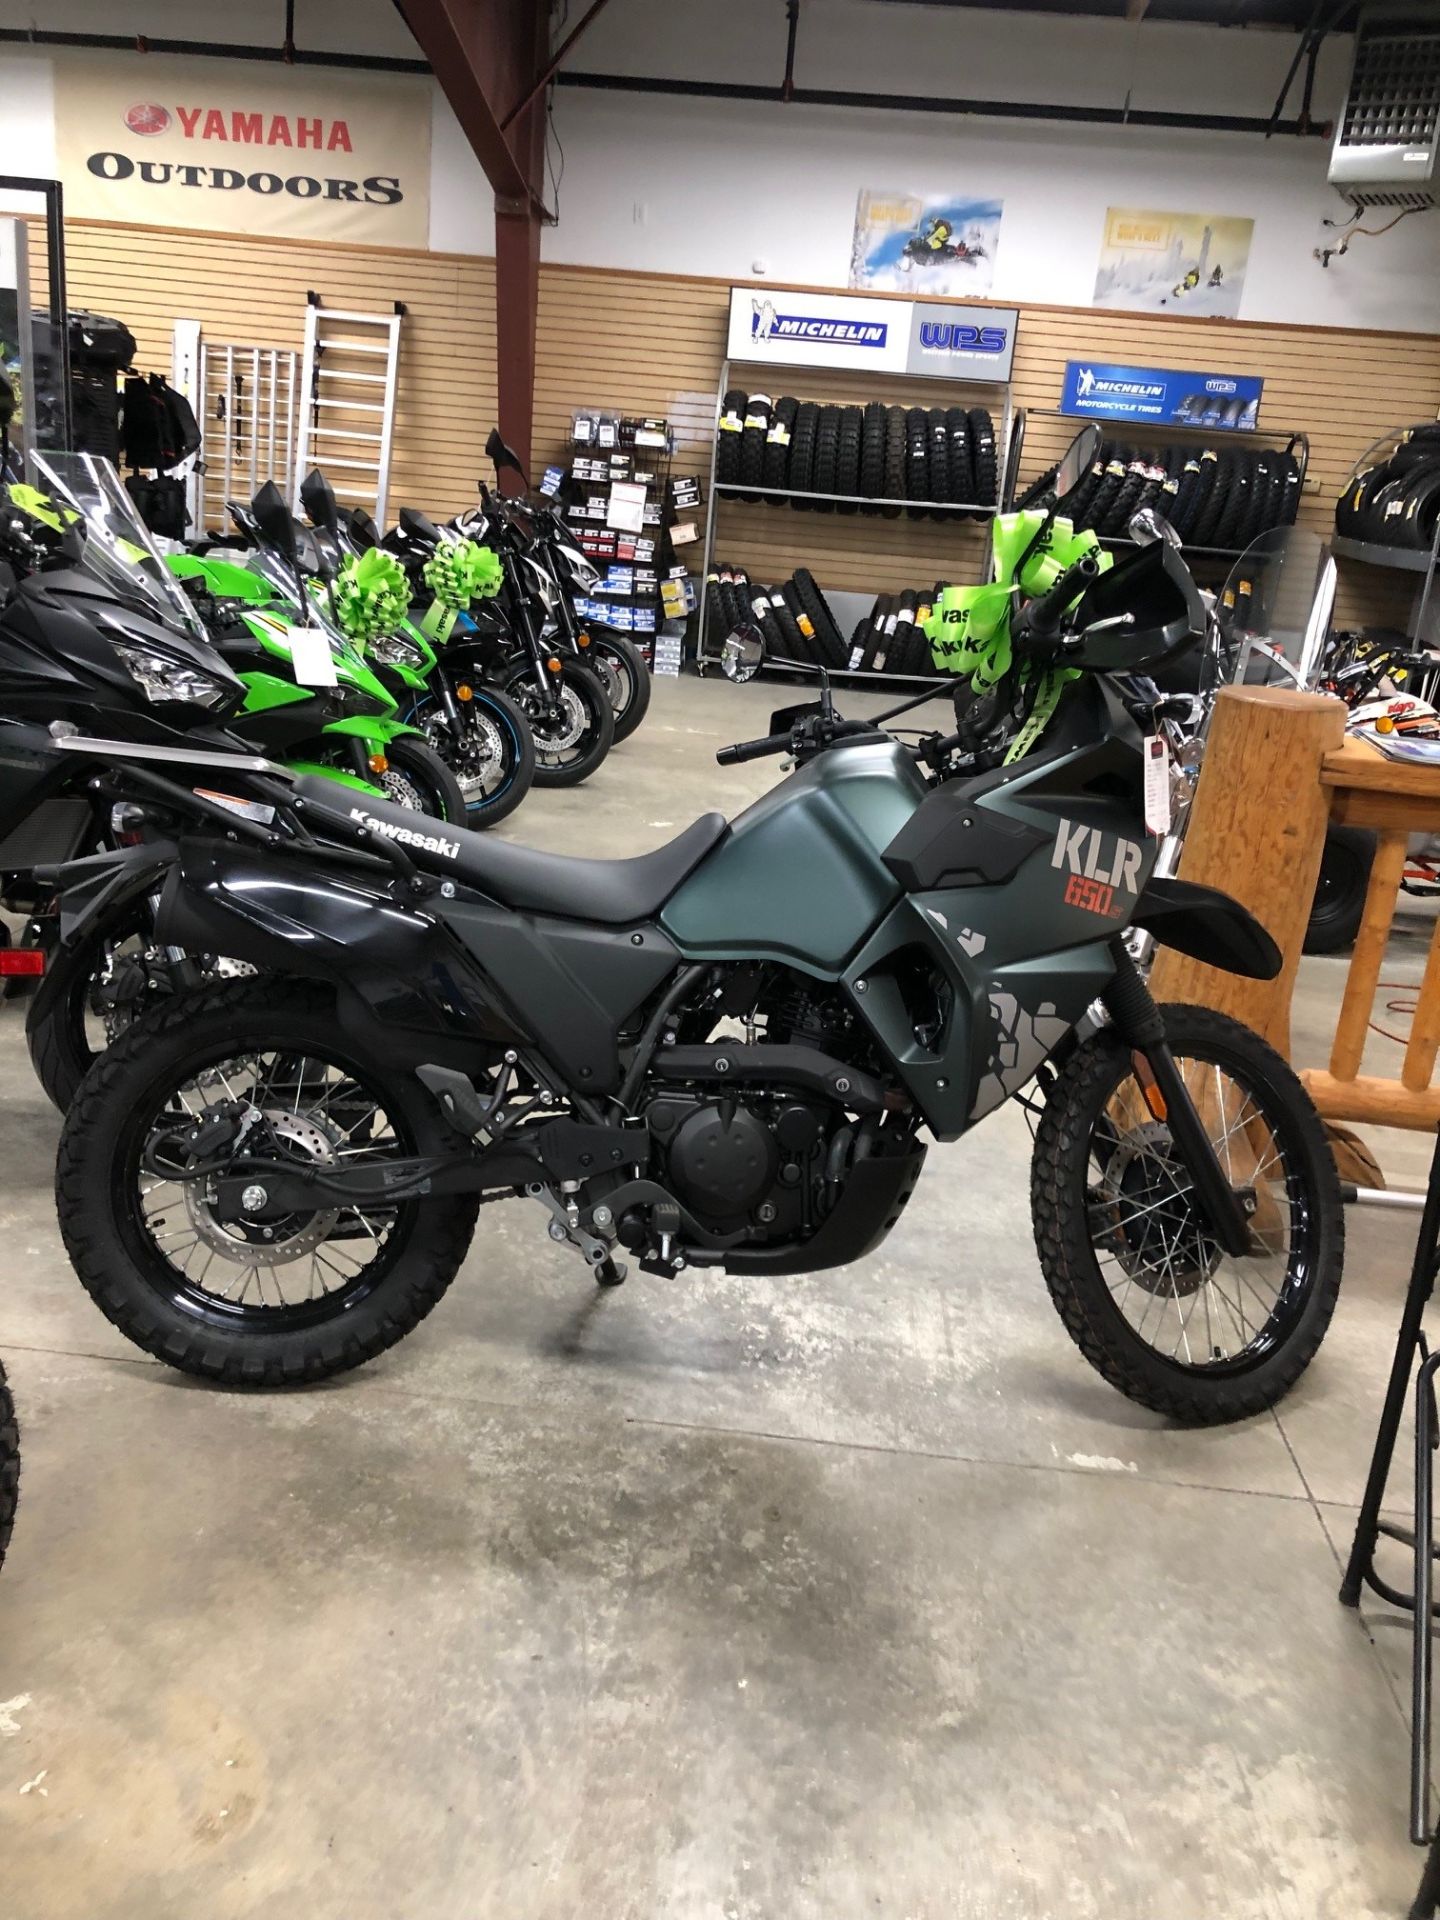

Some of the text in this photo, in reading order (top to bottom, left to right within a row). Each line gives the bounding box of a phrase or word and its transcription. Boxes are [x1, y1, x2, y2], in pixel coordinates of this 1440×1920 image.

[176, 106, 353, 152] YAMAHA
[86, 151, 403, 205] OUTDOORS
[777, 320, 884, 341] MICHELIN
[920, 321, 1007, 353] WPS
[1095, 381, 1163, 396] MICHELIN
[1206, 380, 1237, 393] WPS
[1075, 399, 1136, 412] MOTORCYCLE
[1137, 405, 1163, 414] TIRES
[349, 808, 461, 860] Kawasaki
[1051, 818, 1142, 894] KLR
[1064, 874, 1114, 916] 650
